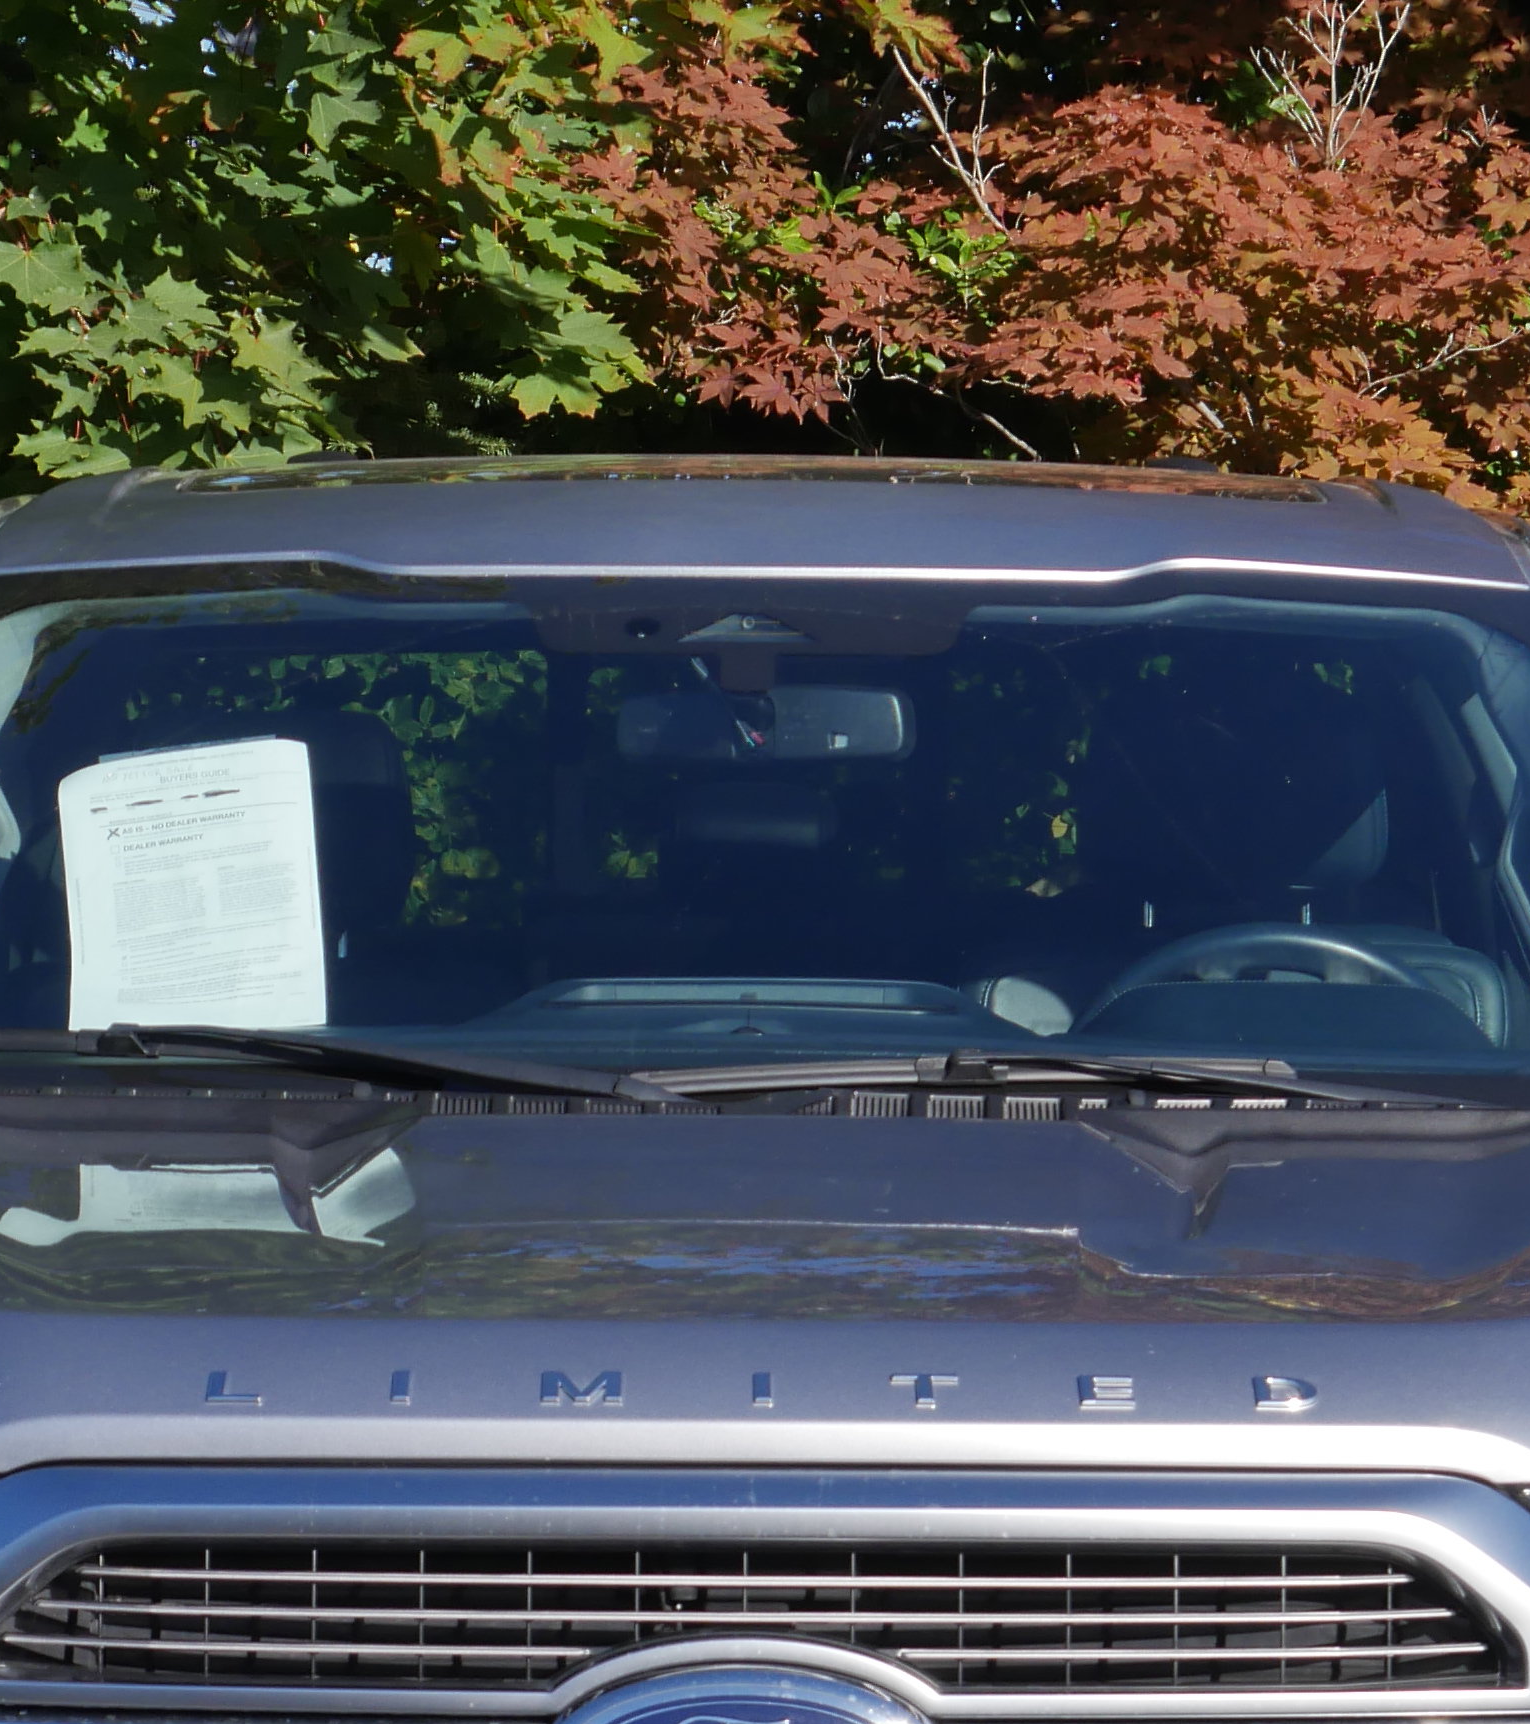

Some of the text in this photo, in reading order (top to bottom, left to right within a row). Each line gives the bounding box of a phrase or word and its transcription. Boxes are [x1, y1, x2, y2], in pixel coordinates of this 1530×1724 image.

[160, 767, 230, 784] BUYERS GUIDE
[122, 827, 133, 835] AS
[136, 825, 144, 833] IS
[152, 823, 165, 831] NO
[166, 818, 198, 828] DEALER
[199, 811, 245, 823] WARRANTY
[123, 838, 157, 851] DEALER
[159, 833, 204, 847] WARRANTY
[204, 1369, 1320, 1412] LIMITED
